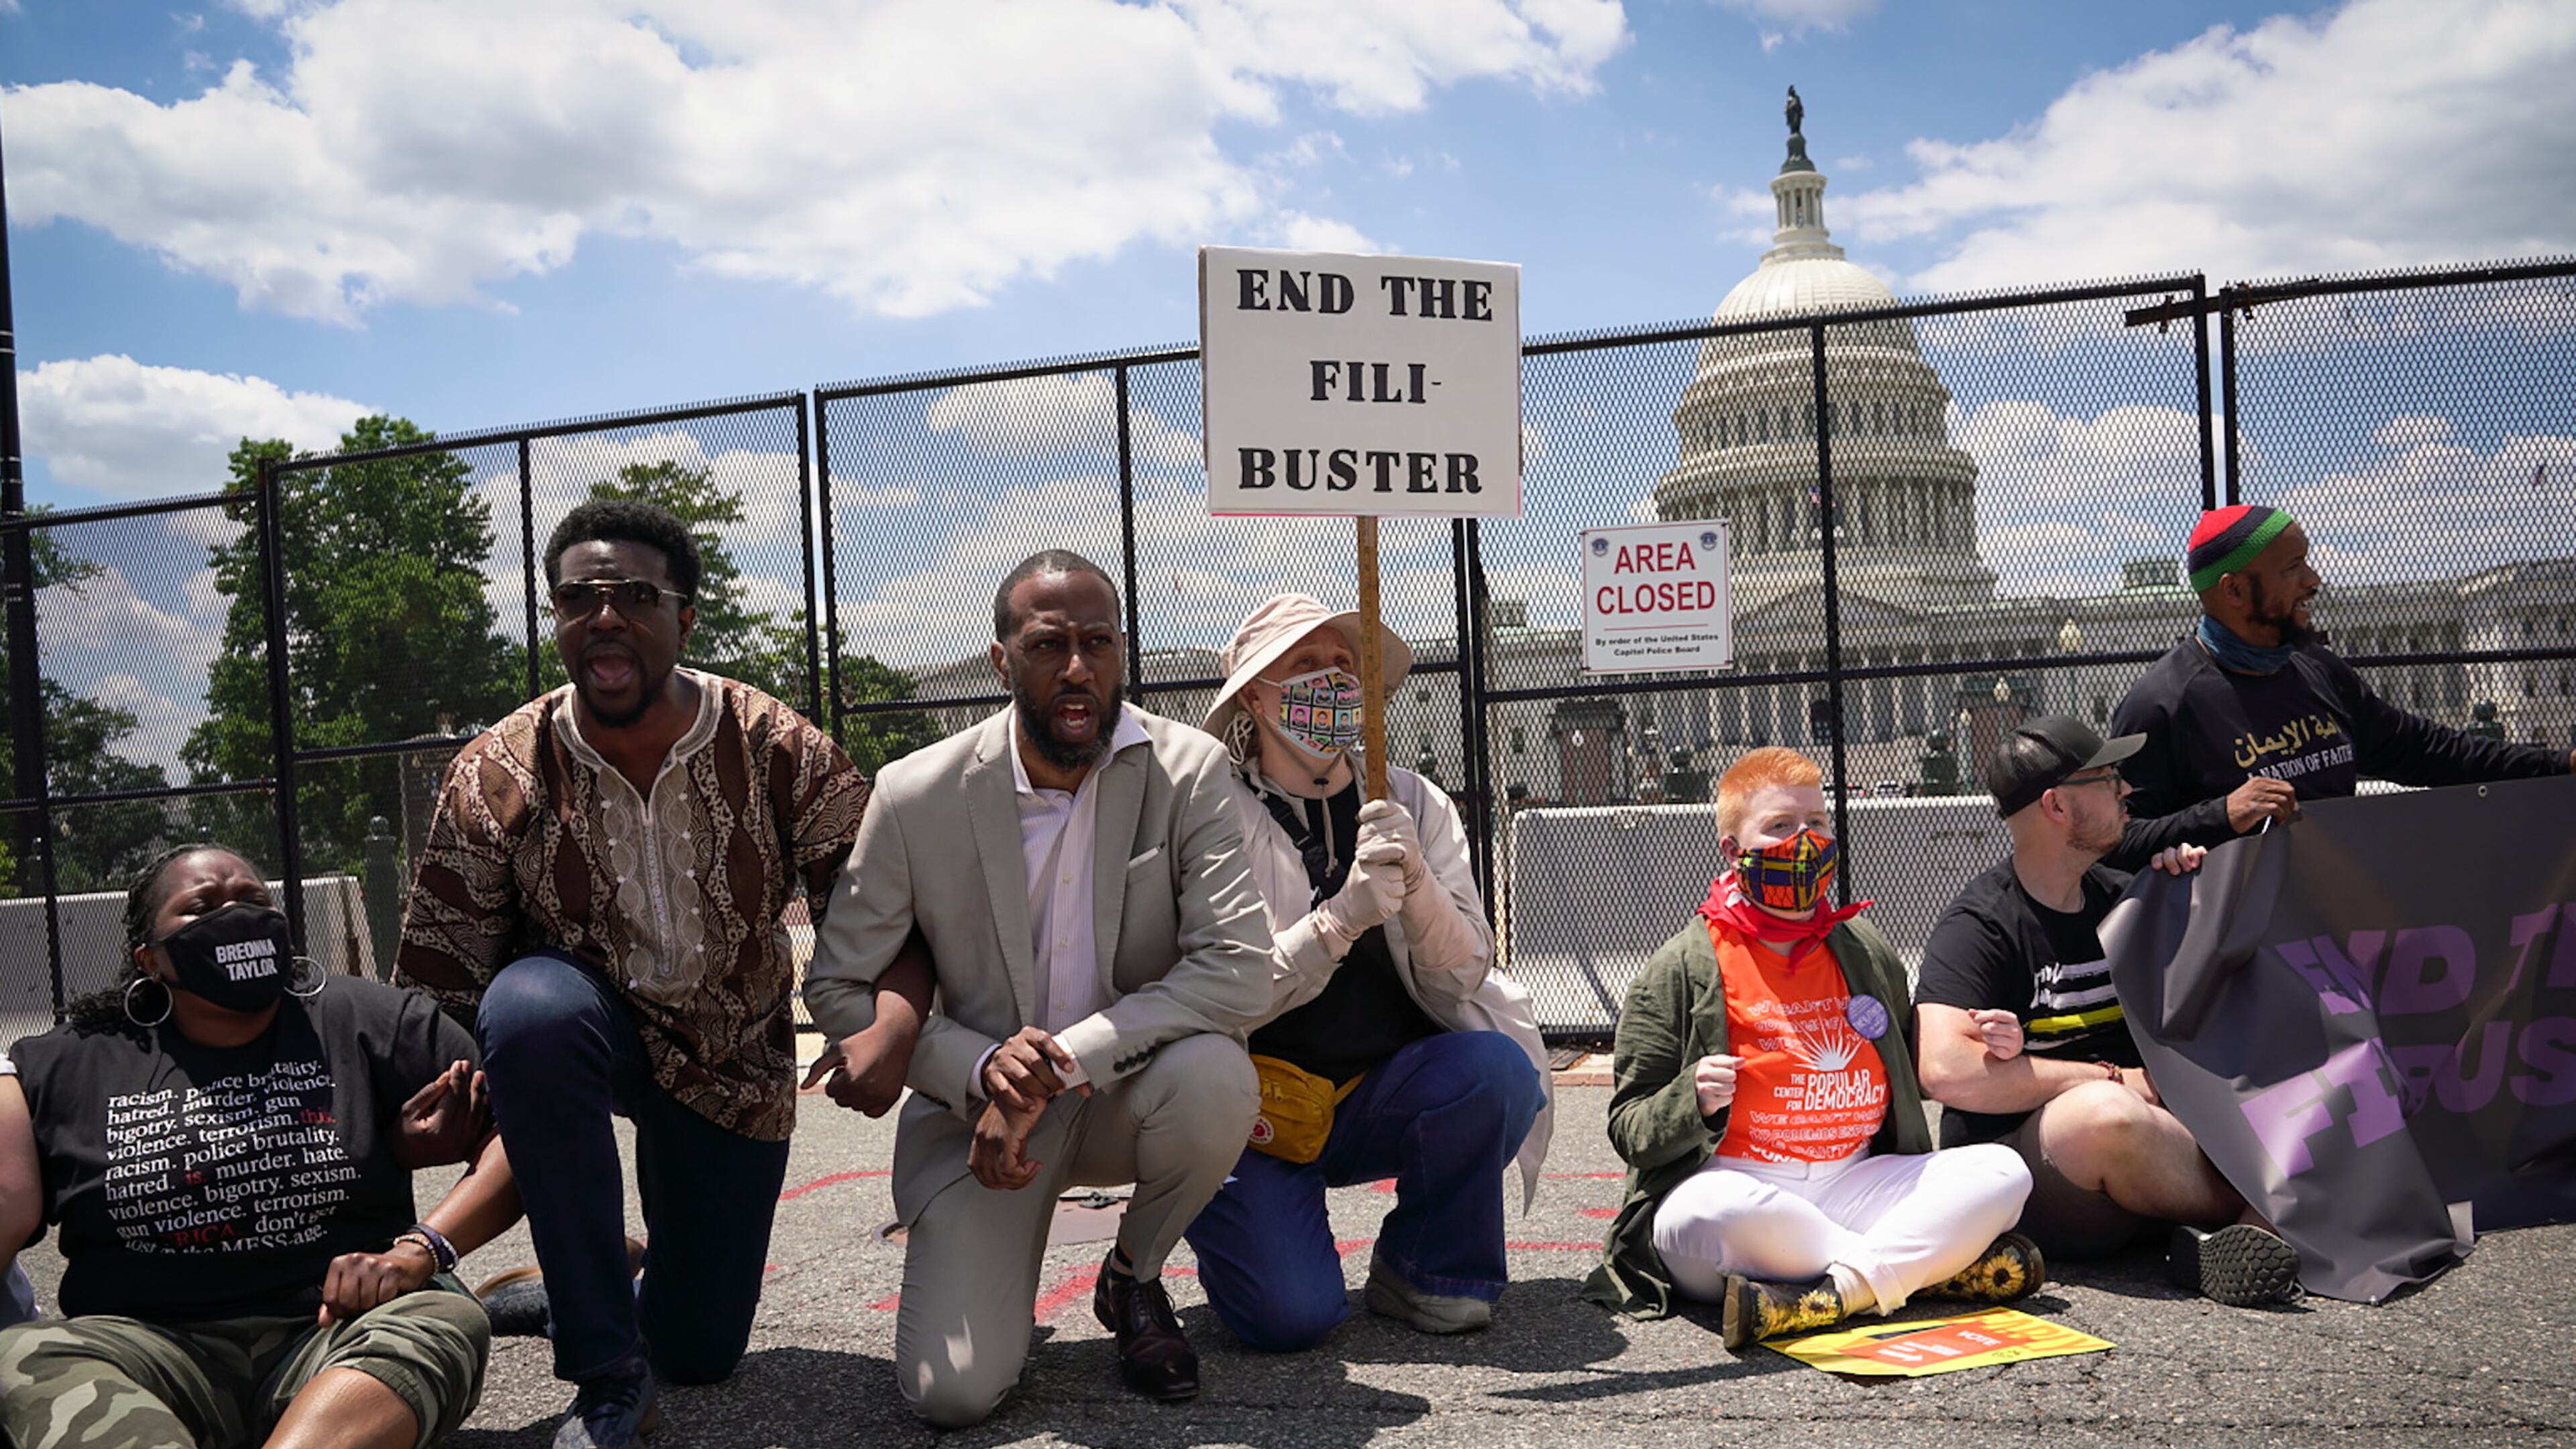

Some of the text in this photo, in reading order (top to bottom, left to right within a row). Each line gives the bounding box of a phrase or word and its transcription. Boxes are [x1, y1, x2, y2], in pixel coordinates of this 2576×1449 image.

[1236, 269, 1493, 321] END THE
[1309, 360, 1442, 404] FILI-
[1238, 447, 1482, 494] BUSTER
[1614, 541, 1696, 574] AREA
[1597, 580, 1716, 615] CLOSED
[1595, 638, 1607, 647] By
[1609, 637, 1631, 645] order
[1633, 637, 1642, 645] of
[1644, 636, 1658, 644] the
[1660, 635, 1689, 643] United
[1613, 645, 1700, 657] Capitol Police Board
[2304, 752, 2321, 772] OF
[215, 938, 277, 964] BREONNA
[225, 958, 278, 981] TAYLOR
[1773, 1086, 1805, 1098] CENTER
[1790, 1073, 1805, 1085] THE
[1807, 1069, 1871, 1093] POPULAR
[107, 1088, 178, 1108] racism.
[107, 1101, 175, 1126] hatred.
[181, 1090, 257, 1114] murder.
[1786, 1099, 1803, 1111] FOR
[1804, 1082, 1886, 1111] DEMOCRACY
[106, 1095, 302, 1145] bigotry. sexism. gun
[106, 1133, 192, 1161] violence.
[199, 1112, 299, 1142] terrorism.
[104, 1126, 339, 1181] racism. police brutality.
[104, 1146, 349, 1201] hatred. is. murder. hate.
[107, 1165, 362, 1221] violence. bigotry. sexism.
[116, 1187, 350, 1240] gun violence. terrorism.
[254, 1209, 305, 1234] don't
[1955, 1330, 2003, 1347] VOTE
